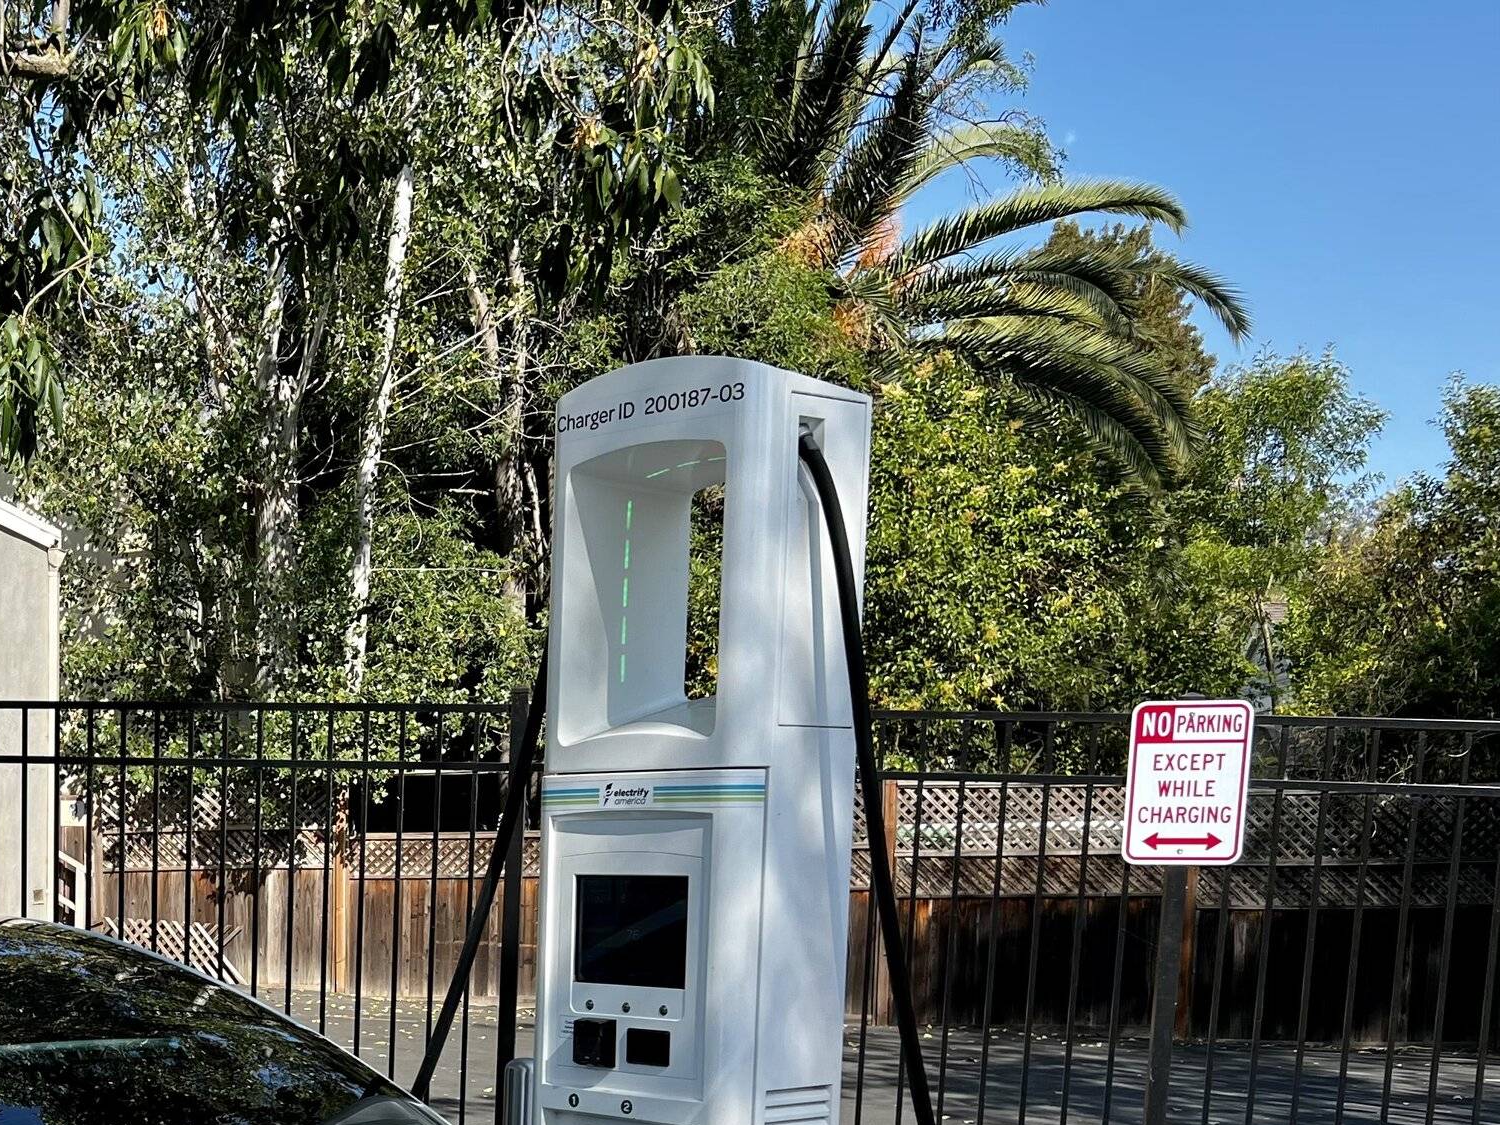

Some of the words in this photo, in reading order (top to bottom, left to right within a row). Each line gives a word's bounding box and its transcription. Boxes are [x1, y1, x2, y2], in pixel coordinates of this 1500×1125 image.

[556, 408, 616, 434] Charger
[618, 401, 636, 420] ID
[643, 382, 746, 416] 200187-03
[1141, 711, 1173, 737] NO
[1176, 713, 1243, 734] PARKING
[1152, 753, 1227, 772] EXCEPT
[613, 788, 649, 798] electrify
[1157, 779, 1217, 798] WHILE
[614, 797, 647, 805] america
[1137, 806, 1233, 824] CHARGING
